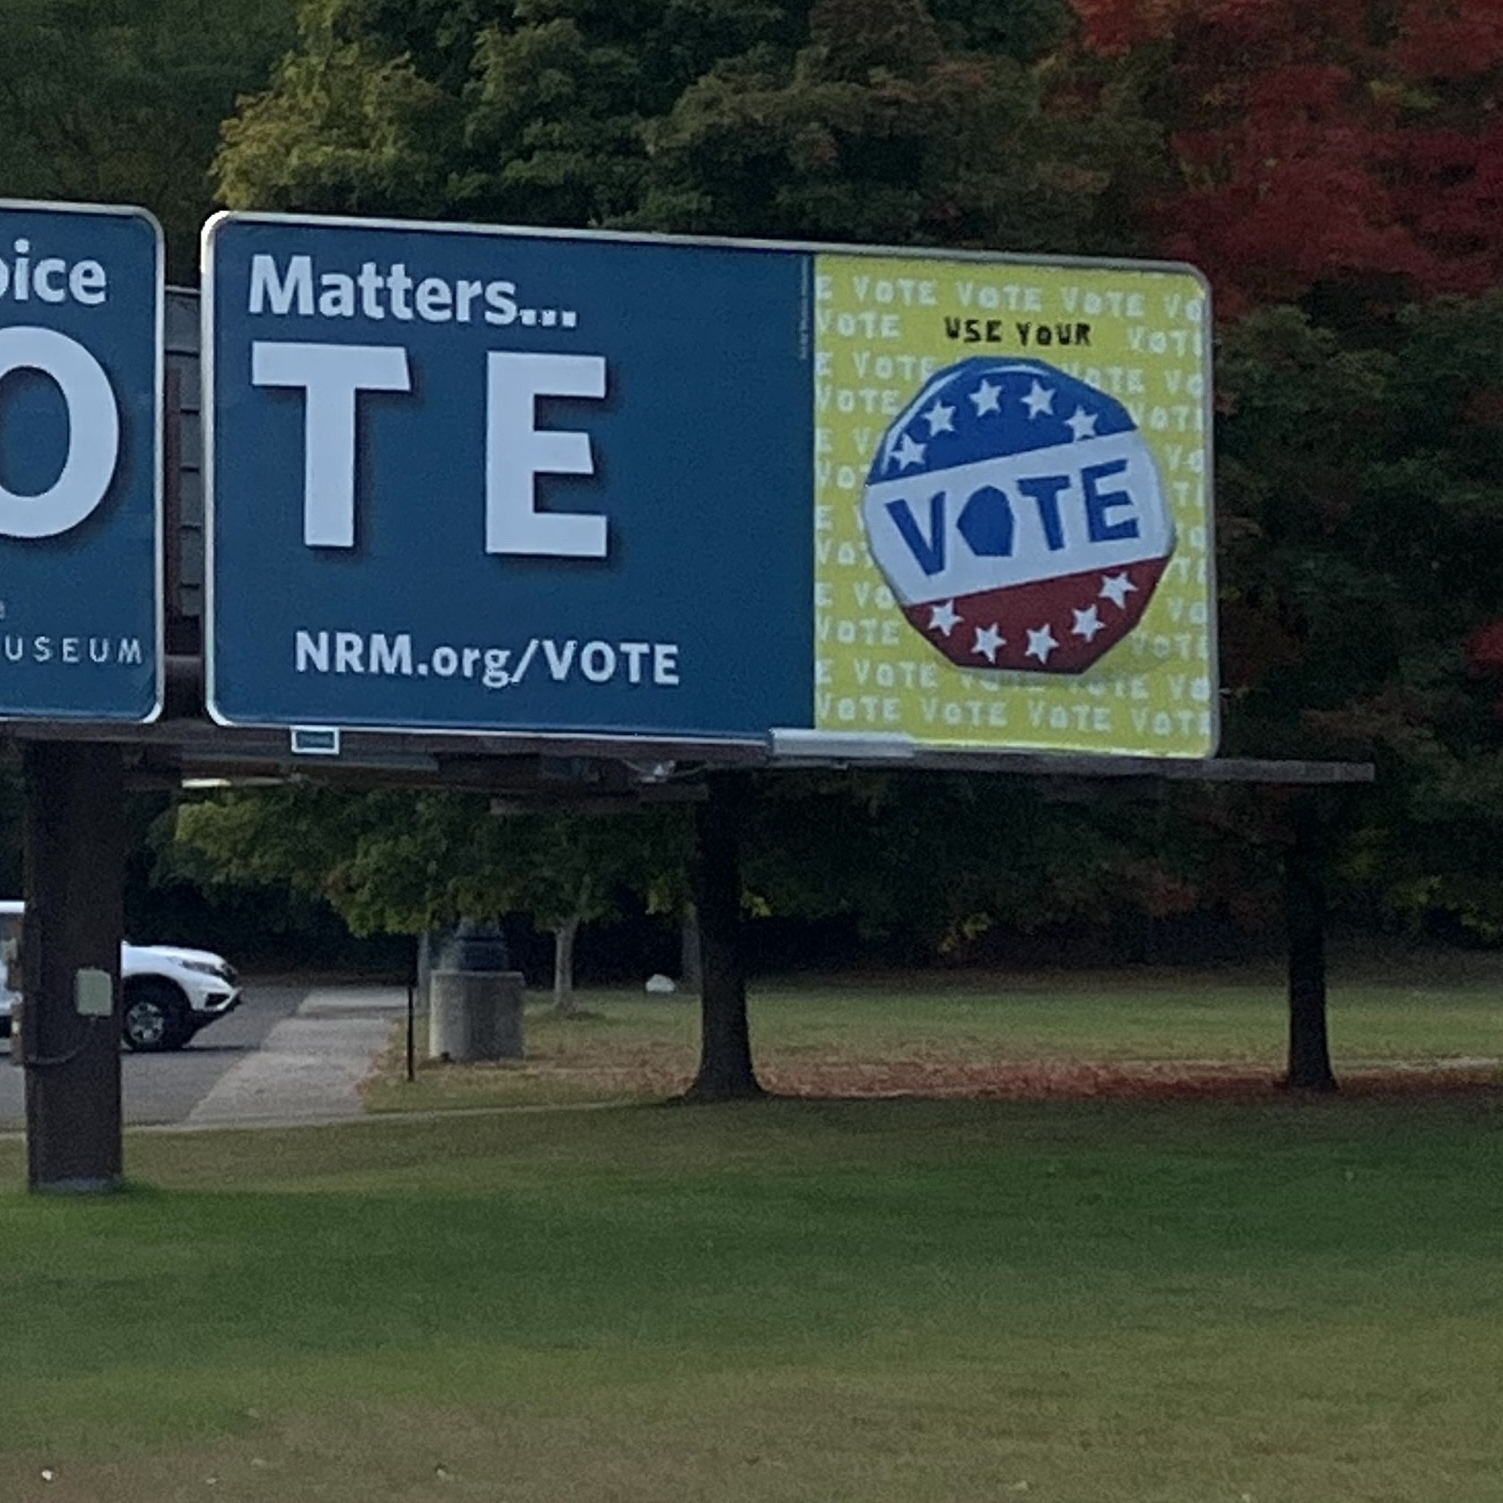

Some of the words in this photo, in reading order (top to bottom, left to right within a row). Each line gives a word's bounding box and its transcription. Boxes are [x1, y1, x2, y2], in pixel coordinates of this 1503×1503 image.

[249, 254, 577, 328] Matters...
[854, 276, 937, 306] VOTE
[956, 280, 1042, 312] VOTE
[1063, 287, 1145, 317] VOTE
[815, 308, 900, 338] VOTE
[944, 316, 1002, 343] USE
[1016, 321, 1091, 347] YOUR
[885, 458, 1140, 577] VOTE
[815, 615, 900, 646] VOTE
[296, 630, 680, 689] NRM.org/VOTE
[853, 658, 938, 688] VOTE
[815, 692, 900, 722] VOTE
[921, 697, 1008, 727] VOTE
[1028, 700, 1111, 733] VOTE
